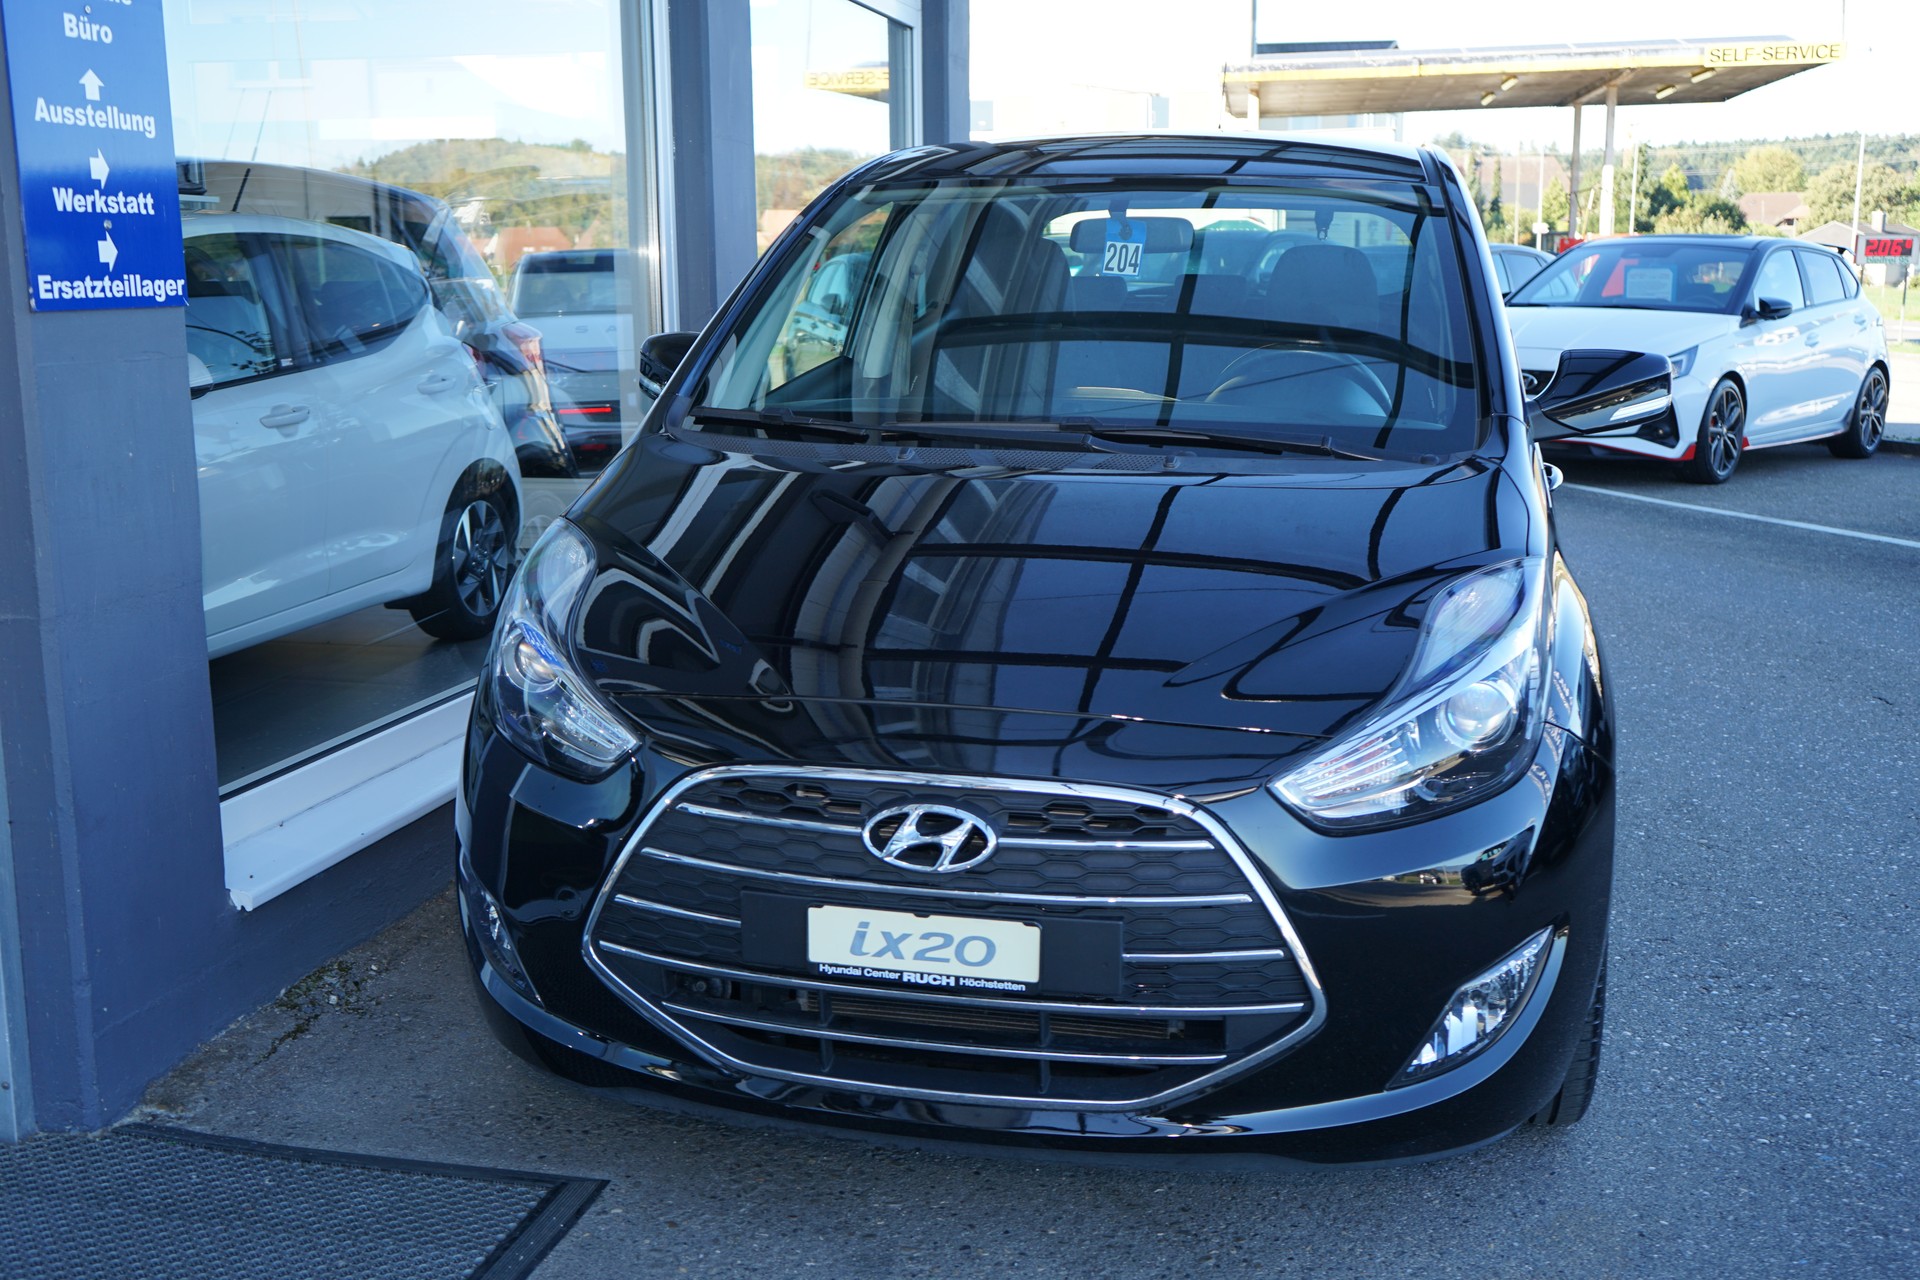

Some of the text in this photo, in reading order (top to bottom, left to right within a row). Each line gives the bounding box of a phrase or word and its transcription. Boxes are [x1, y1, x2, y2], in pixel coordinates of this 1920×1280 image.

[63, 12, 113, 44] Büro
[1709, 44, 1841, 63] SELF-SERVICE
[35, 97, 156, 139] Ausstellung
[52, 187, 155, 216] Werkstatt
[1104, 243, 1140, 274] 204
[37, 274, 185, 303] Ersatzteillager
[849, 921, 996, 967] ix20
[819, 964, 1026, 992] Hyundai Center RUCH Höchstetten
